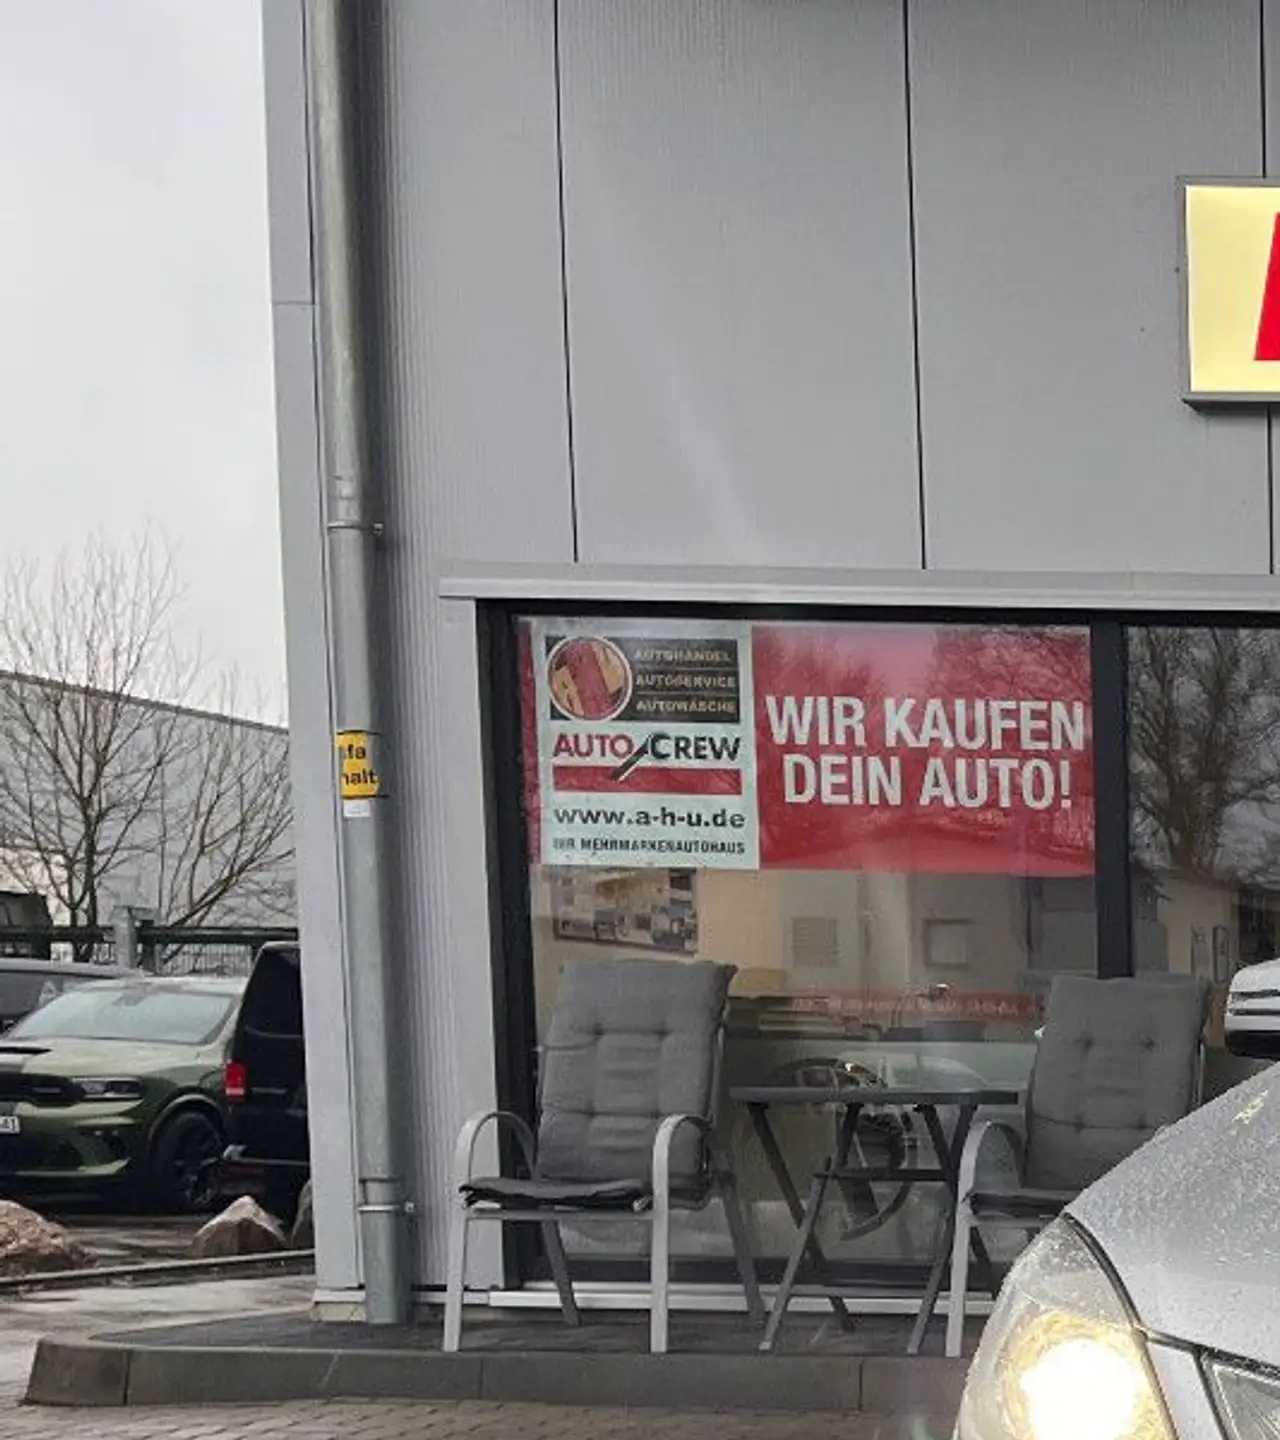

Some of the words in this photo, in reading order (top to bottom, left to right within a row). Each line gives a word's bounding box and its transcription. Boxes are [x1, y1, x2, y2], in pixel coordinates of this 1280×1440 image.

[634, 648, 731, 664] AUTOHANDEL
[635, 673, 736, 690] AUTOSERVICE
[765, 695, 867, 746] WIR
[884, 697, 1084, 750] KAUFEN
[553, 732, 634, 758] AUTO
[650, 732, 741, 762] CREW
[783, 753, 901, 806] DEIN
[919, 757, 1072, 809] AUTO!
[554, 806, 746, 829] www.a-h-u.de
